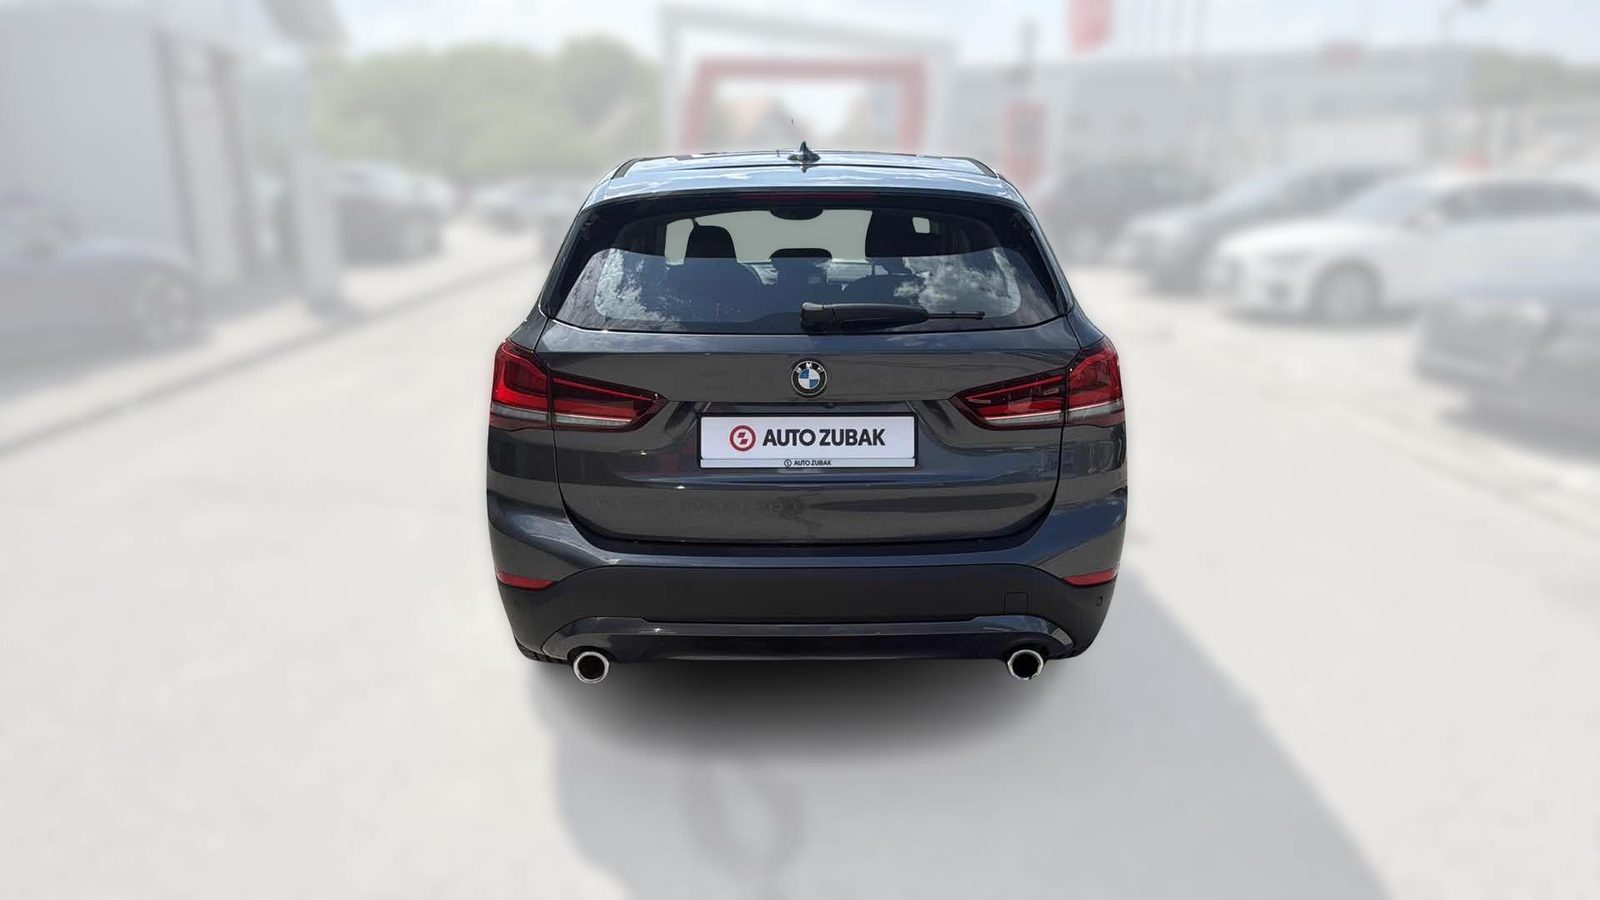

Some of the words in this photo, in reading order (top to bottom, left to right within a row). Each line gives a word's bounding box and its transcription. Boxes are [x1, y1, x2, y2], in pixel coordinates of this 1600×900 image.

[795, 362, 825, 374] BMW
[762, 429, 816, 446] AUTO
[819, 429, 886, 446] ZUBAK
